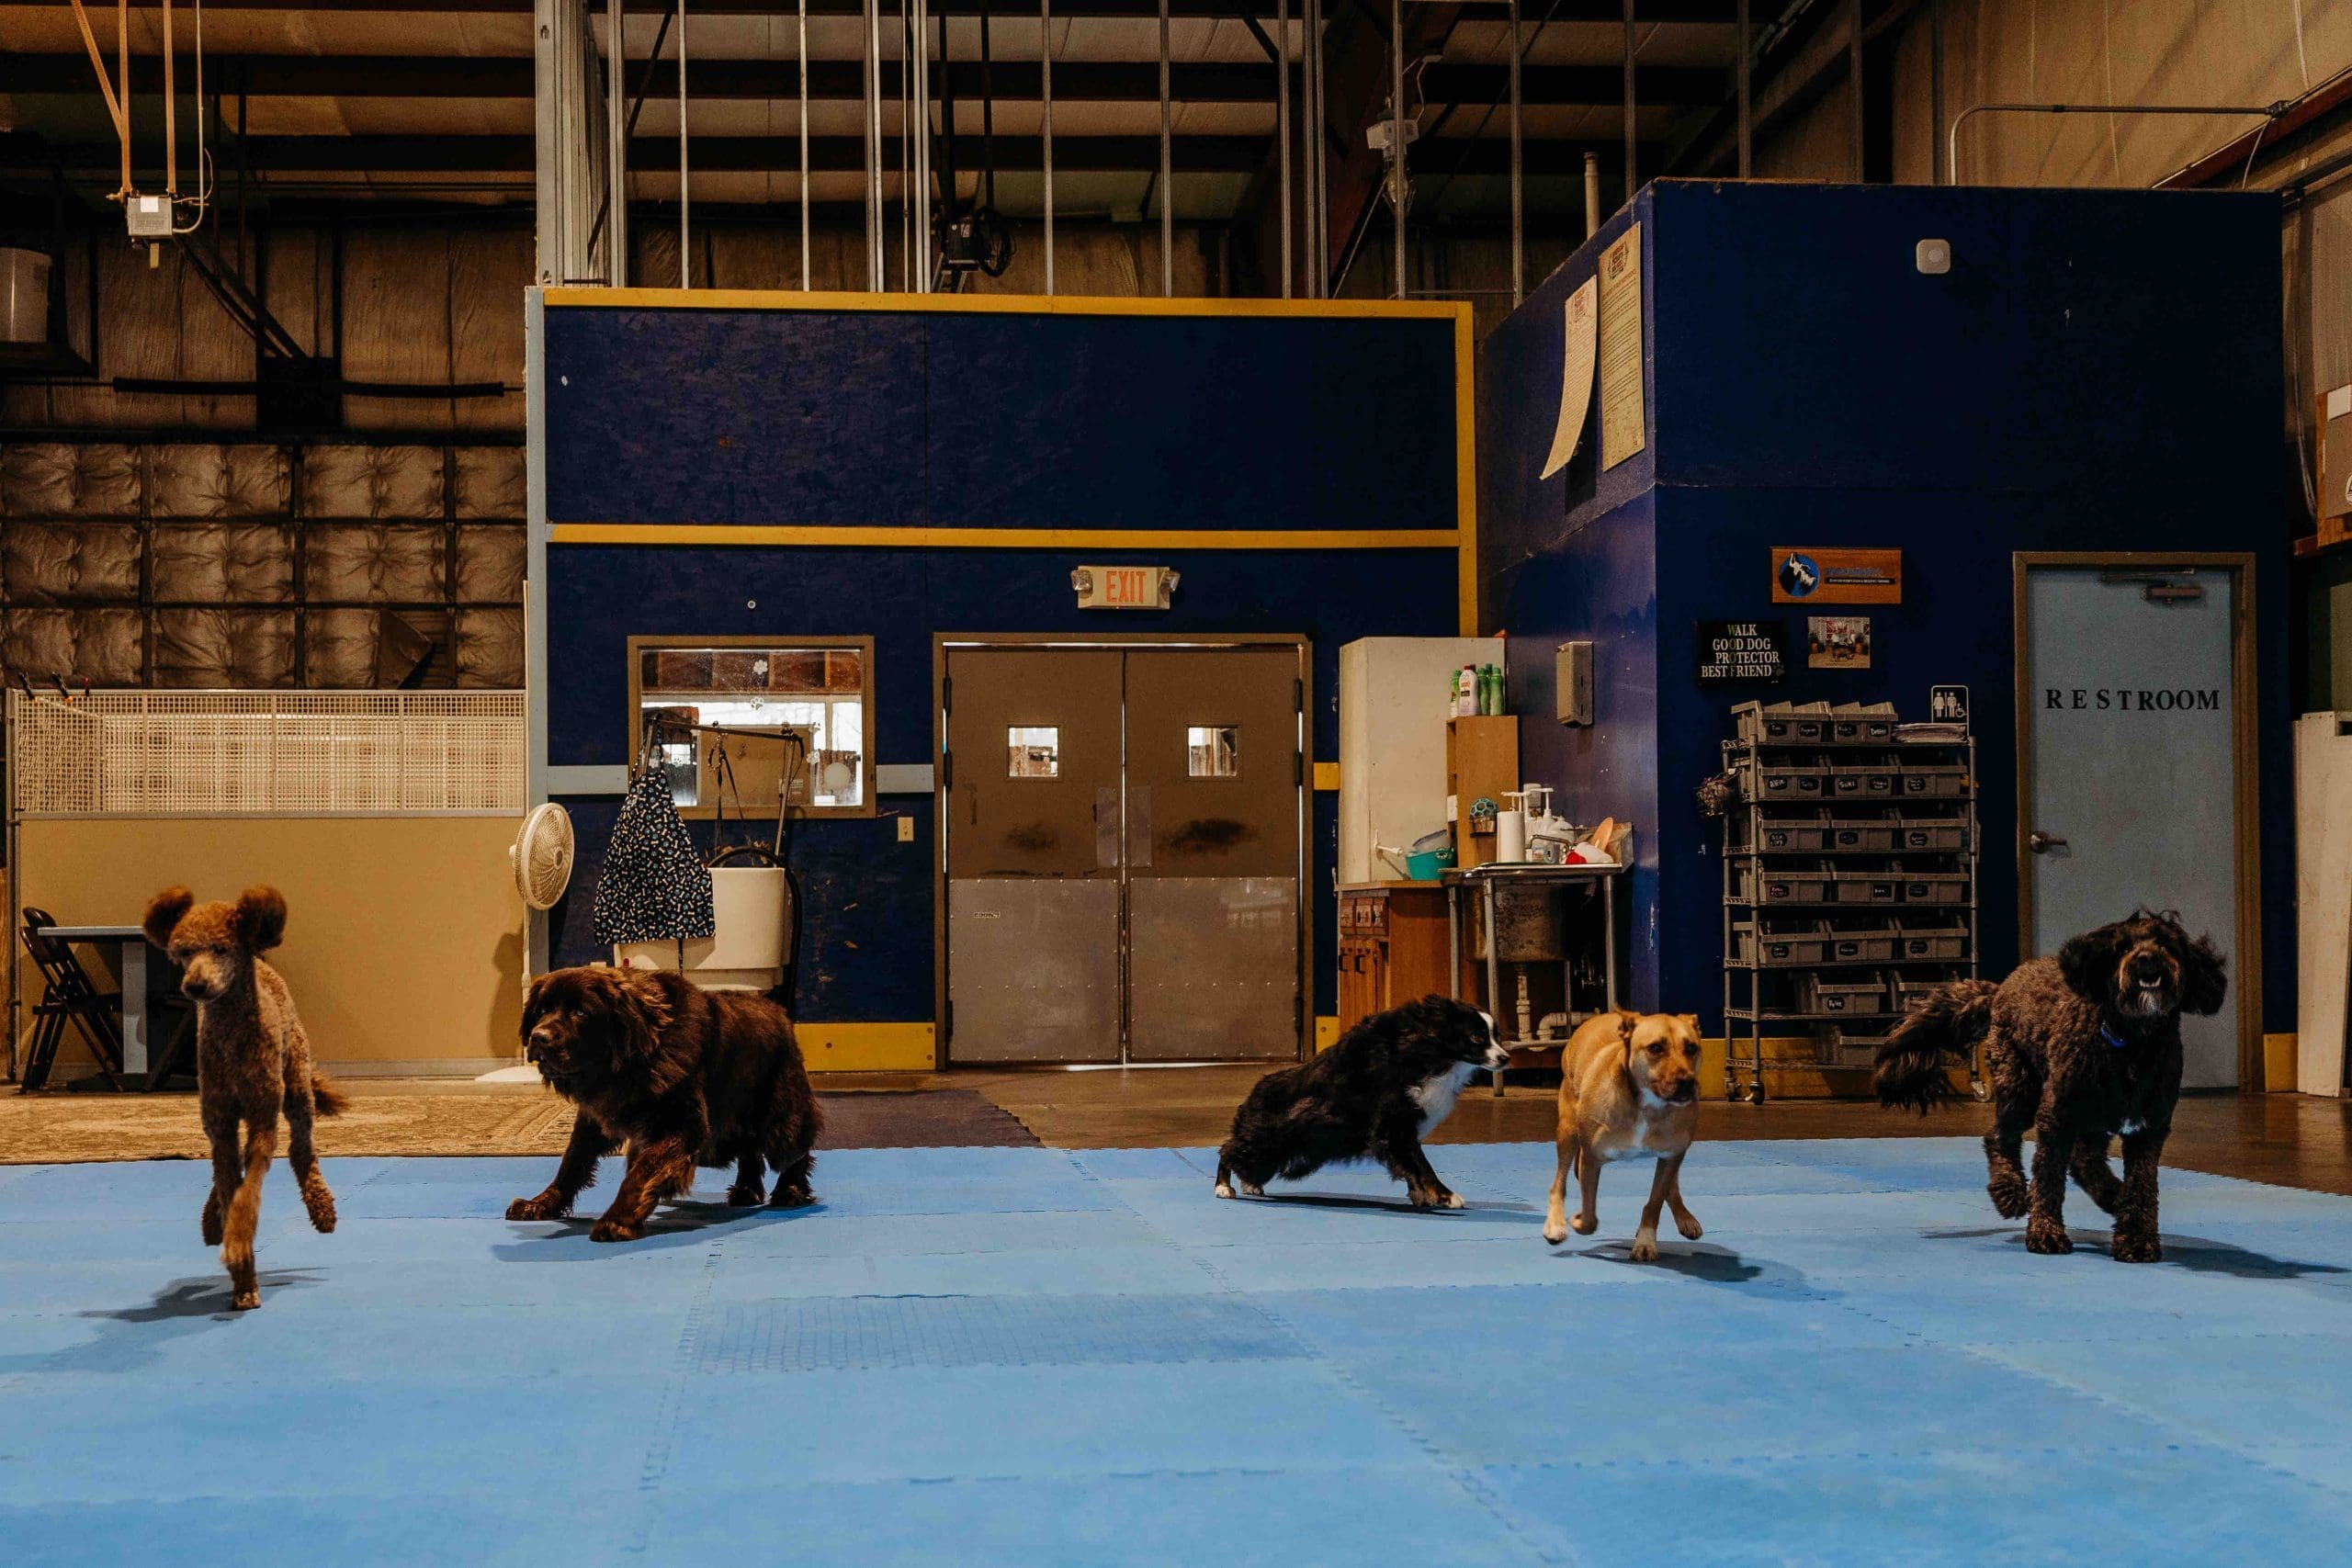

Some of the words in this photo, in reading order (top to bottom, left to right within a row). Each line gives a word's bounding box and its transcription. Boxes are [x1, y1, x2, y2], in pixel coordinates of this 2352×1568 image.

[1106, 570, 1147, 603] EXIT
[1728, 624, 1758, 636] WALK
[1713, 638, 1744, 650] GOOD
[1747, 637, 1770, 650] DOG
[1715, 651, 1780, 664] PROTECTOR
[1702, 666, 1728, 677] BEST
[1730, 665, 1772, 677] FRIEND
[2045, 689, 2220, 711] RESTROOM
